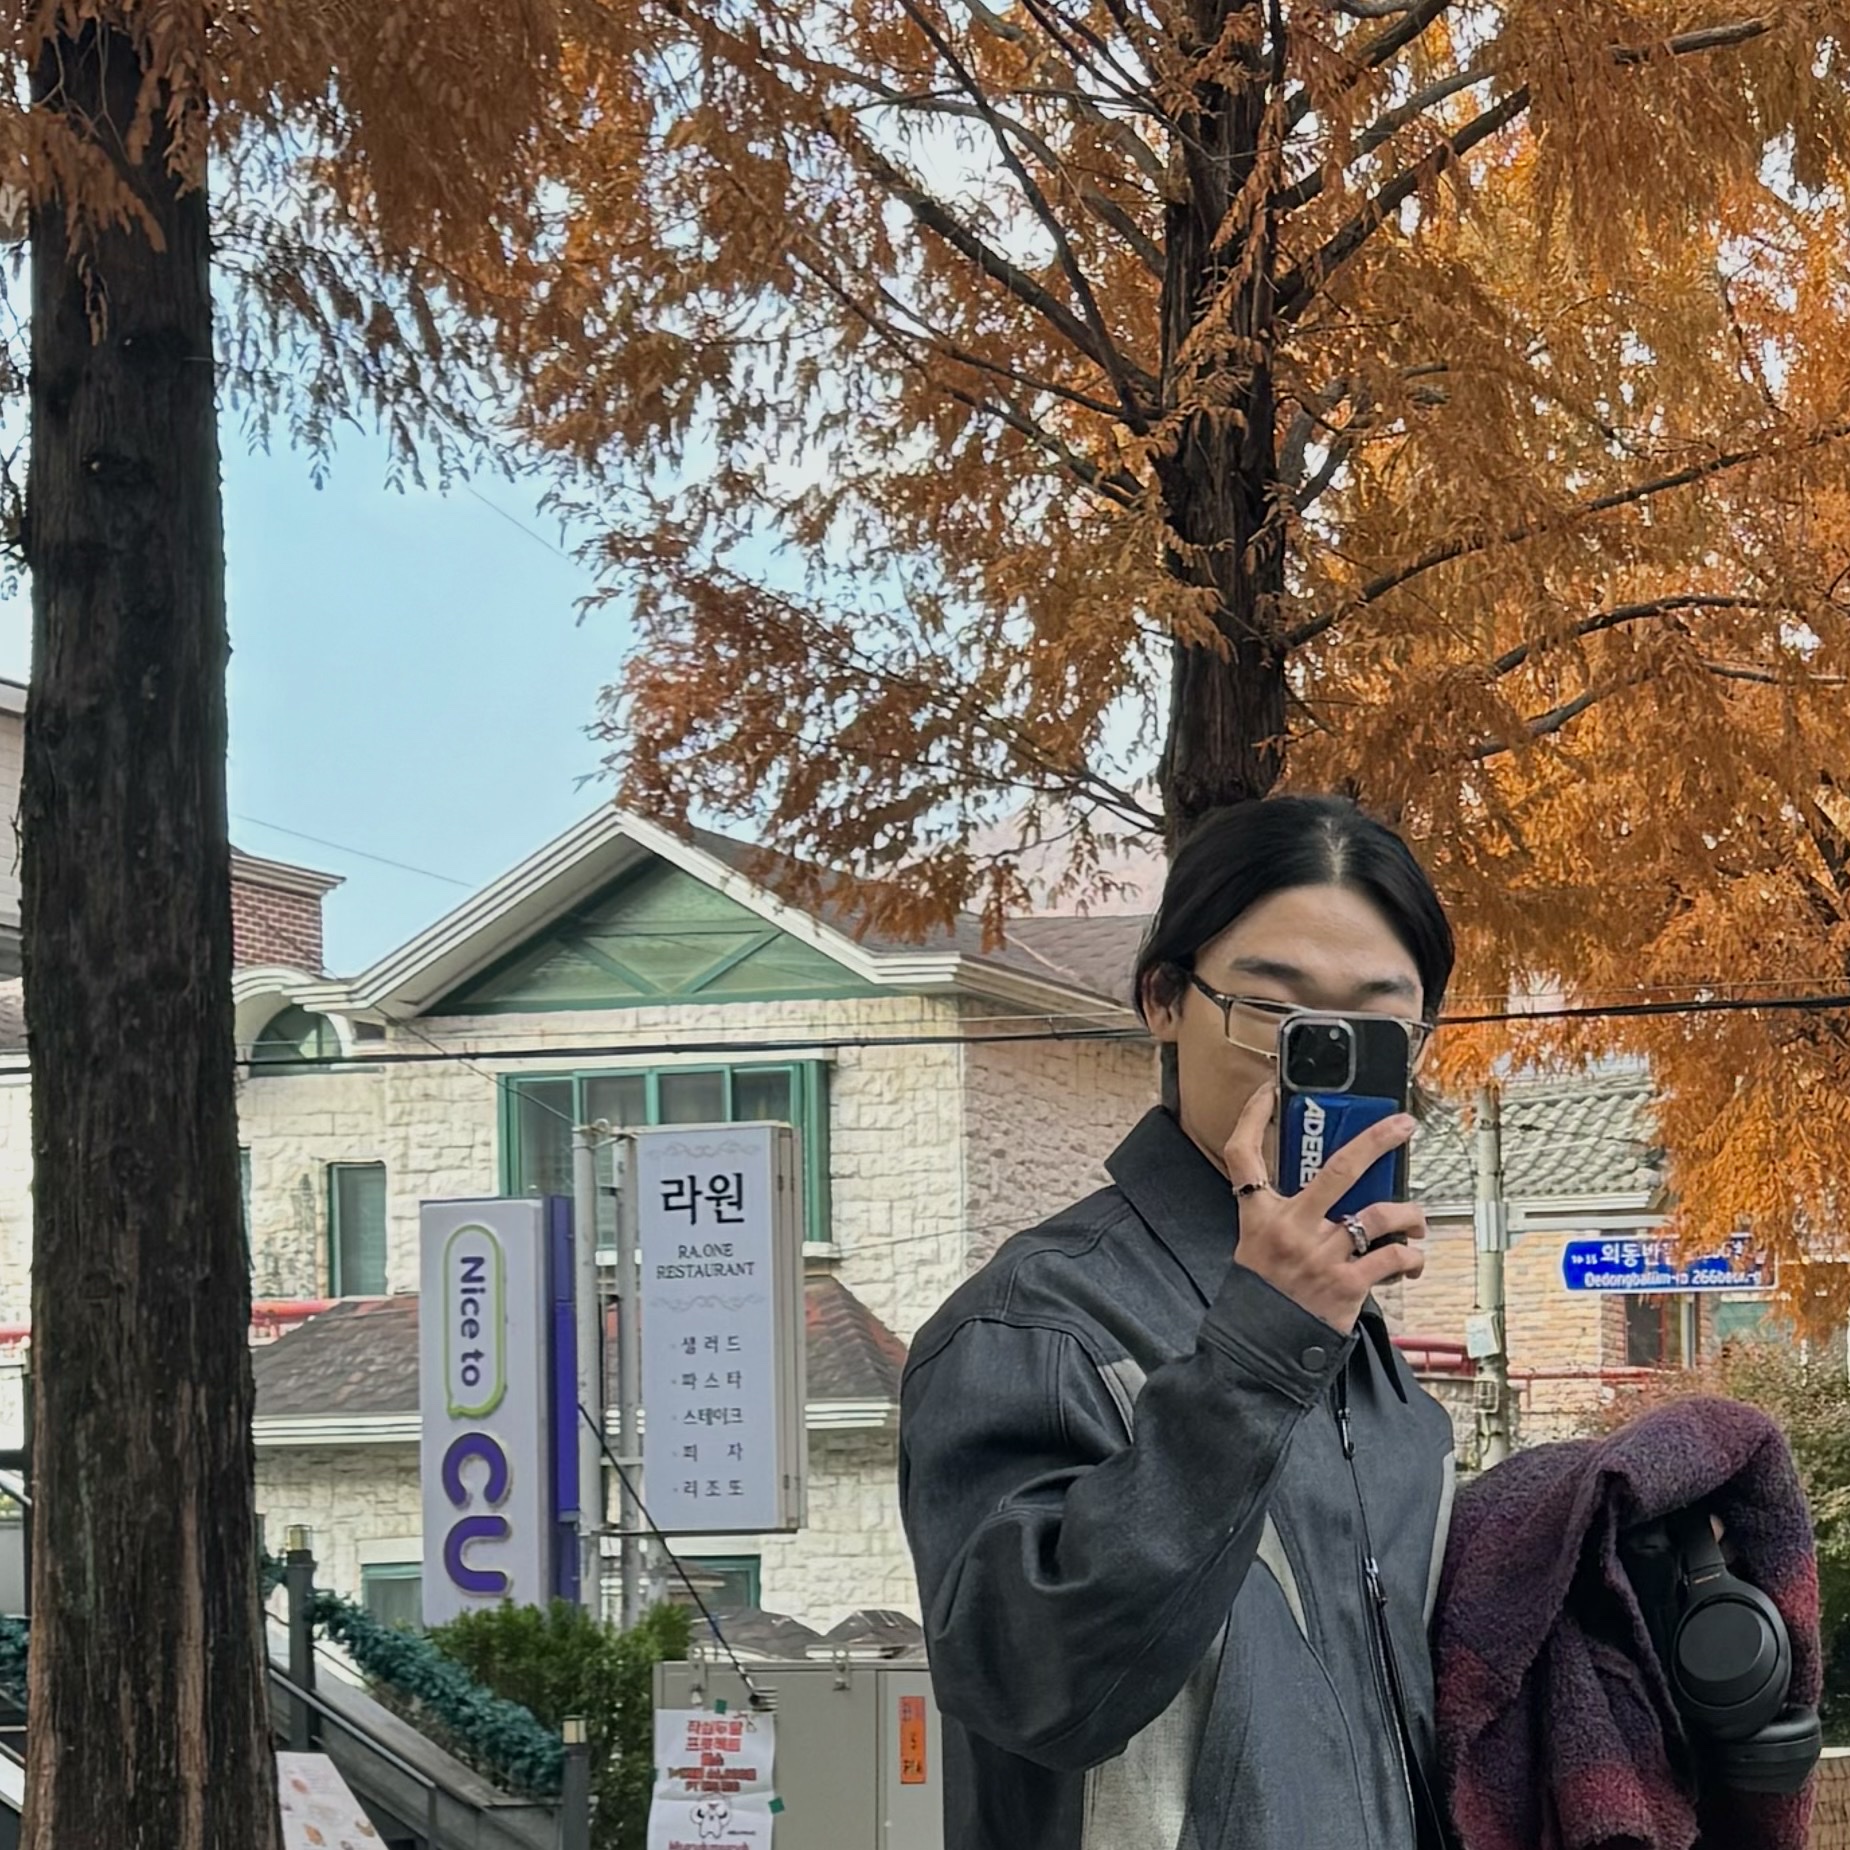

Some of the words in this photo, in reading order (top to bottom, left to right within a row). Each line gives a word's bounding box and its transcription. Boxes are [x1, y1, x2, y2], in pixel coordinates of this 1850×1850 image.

[660, 1172, 745, 1226] 라원
[656, 1261, 756, 1279] RESTAURANT
[460, 1256, 486, 1340] Nice
[461, 1348, 485, 1387] to
[681, 1370, 742, 1390] 파스타
[682, 1406, 744, 1426] 스테이크
[442, 1432, 509, 1595] CU
